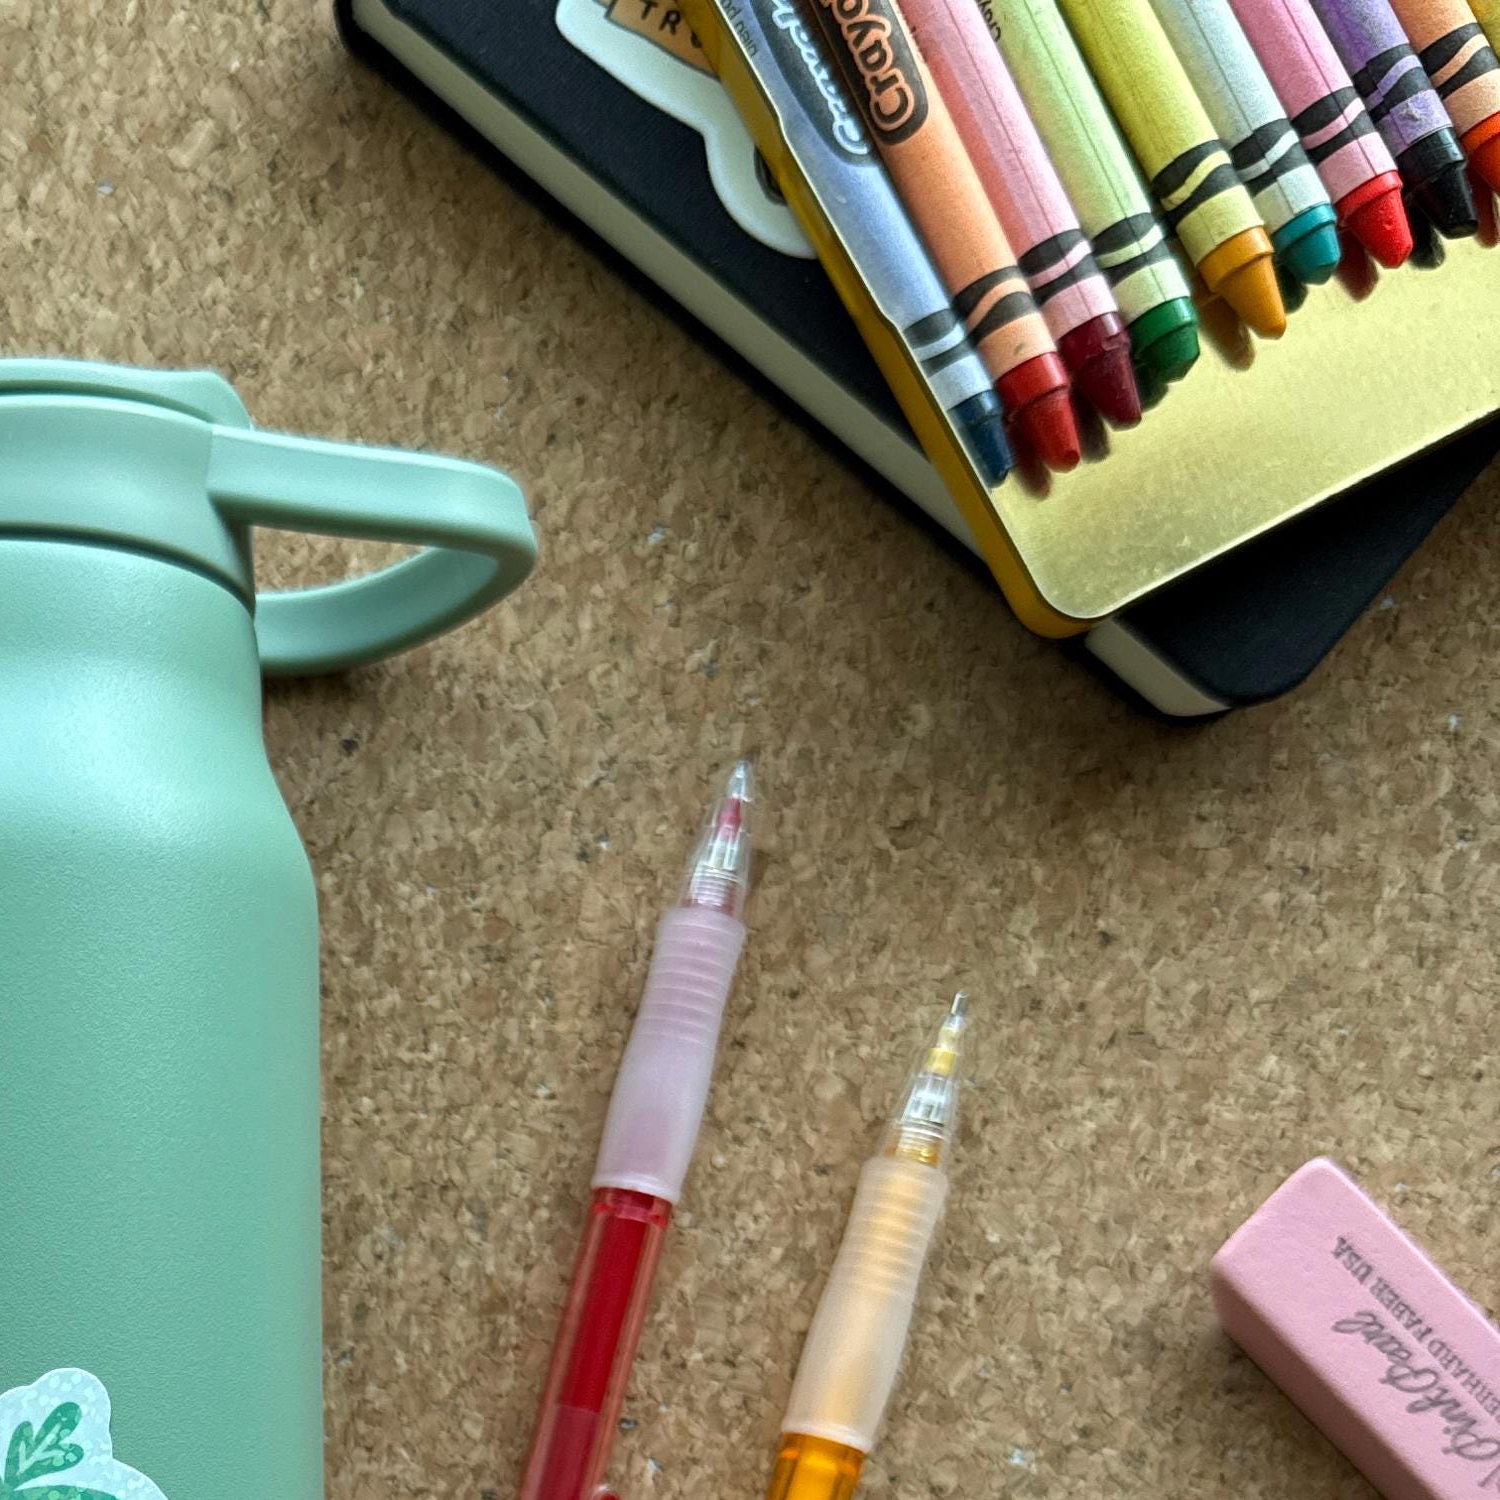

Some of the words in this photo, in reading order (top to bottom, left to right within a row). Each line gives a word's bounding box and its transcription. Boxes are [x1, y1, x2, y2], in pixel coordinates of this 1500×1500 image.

[639, 0, 702, 49] TR
[1331, 1236, 1373, 1286] USA
[1369, 1277, 1433, 1343] FABER
[1331, 1310, 1439, 1394] Pearl
[1406, 1387, 1500, 1461] Pink
